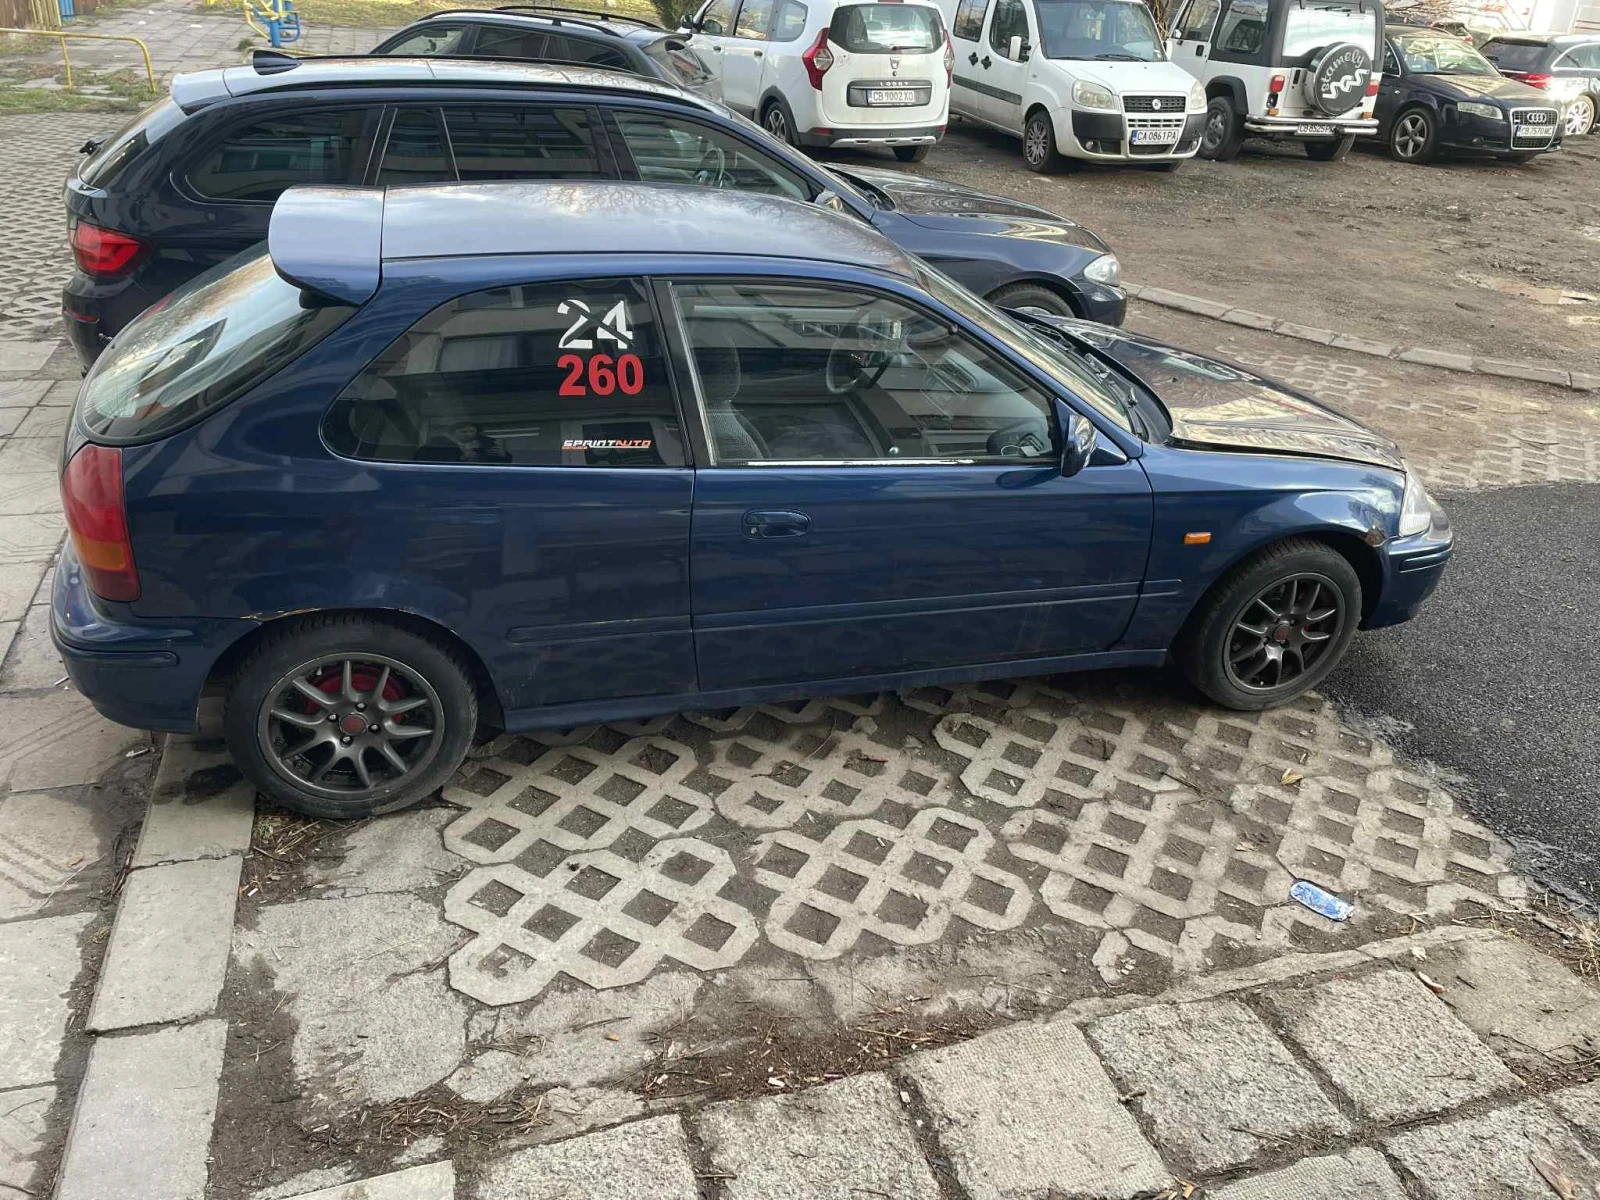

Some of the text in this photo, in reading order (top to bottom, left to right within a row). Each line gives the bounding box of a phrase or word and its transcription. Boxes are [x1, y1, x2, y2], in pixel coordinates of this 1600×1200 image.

[1321, 49, 1365, 92] stamely
[557, 299, 633, 349] 24
[557, 353, 644, 396] 260
